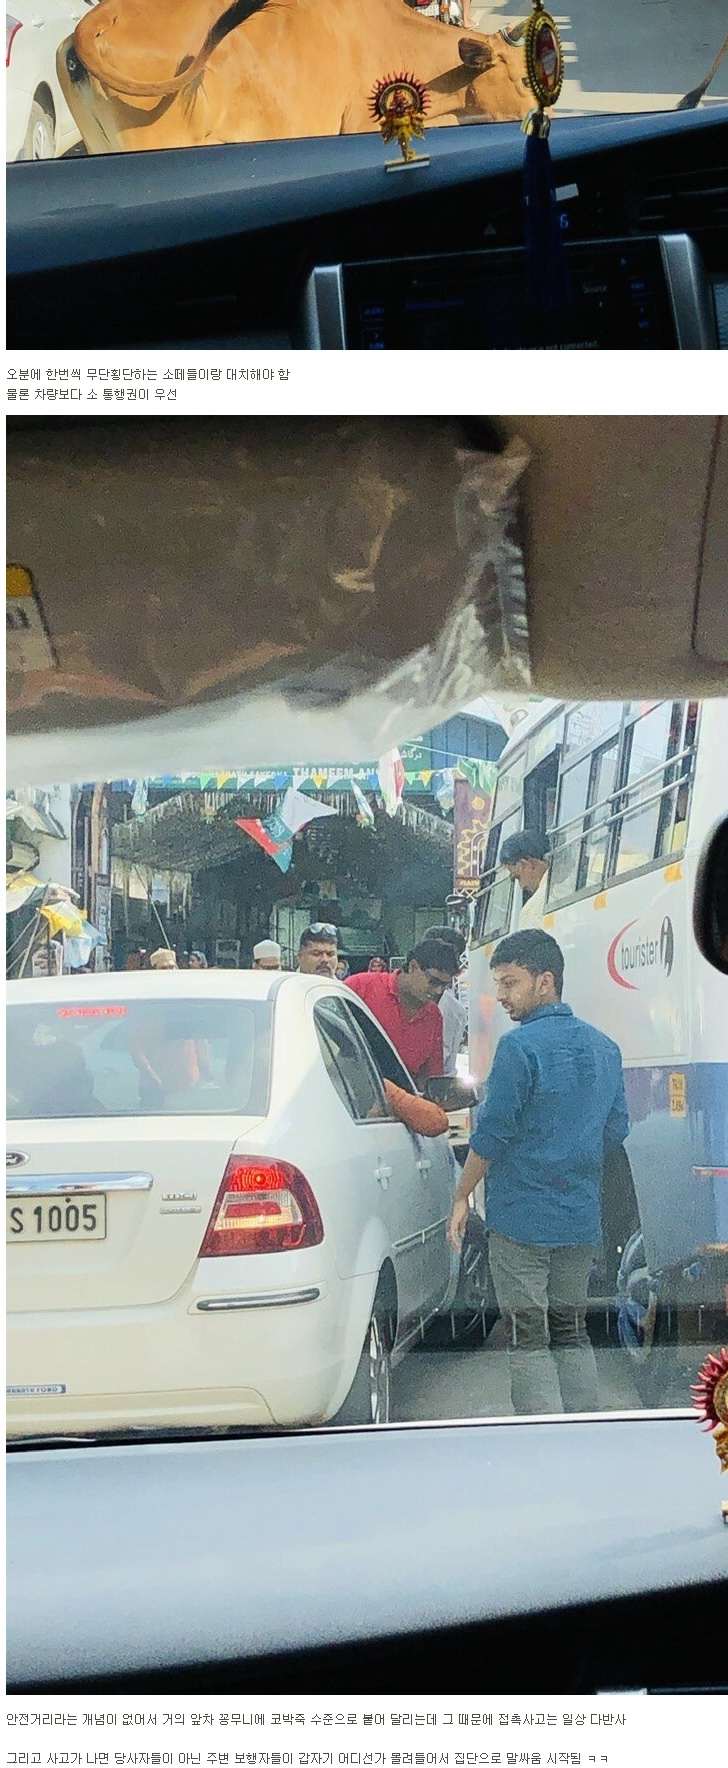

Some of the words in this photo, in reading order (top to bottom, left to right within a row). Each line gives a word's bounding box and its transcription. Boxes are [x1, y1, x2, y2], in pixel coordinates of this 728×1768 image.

[621, 936, 659, 970] tourister
[10, 1207, 24, 1233] S
[33, 1203, 97, 1233] 1005
